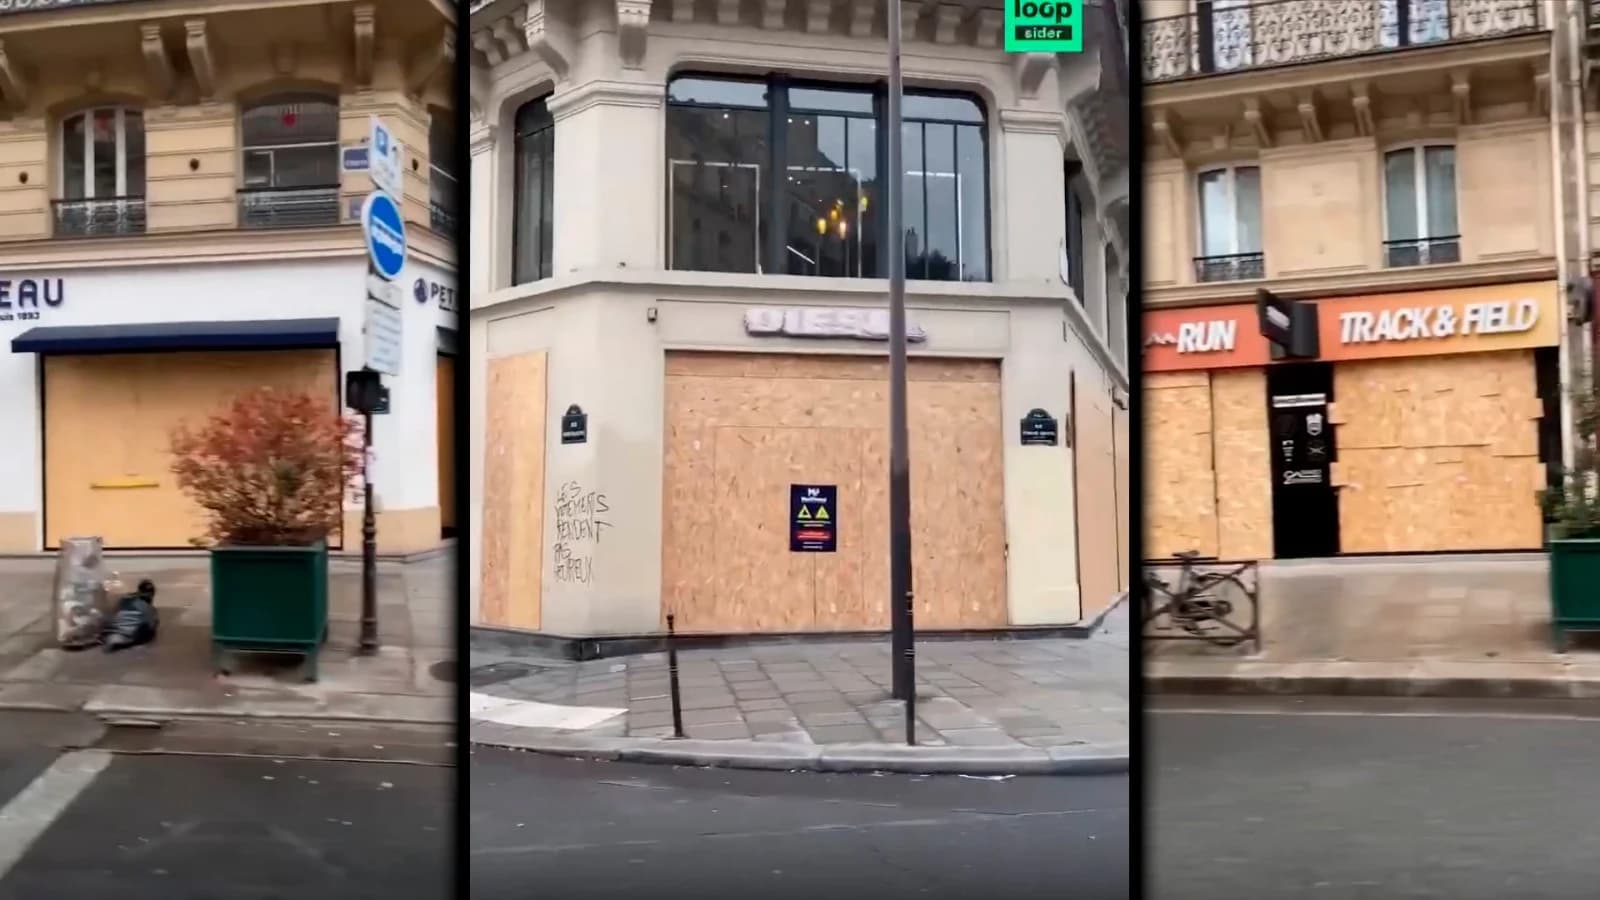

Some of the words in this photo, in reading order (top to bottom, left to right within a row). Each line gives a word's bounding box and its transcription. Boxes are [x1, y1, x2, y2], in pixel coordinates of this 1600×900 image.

[1177, 320, 1237, 354] RUN
[1339, 307, 1434, 344] TRACK
[1432, 304, 1459, 338] &
[1461, 298, 1540, 335] FIELD
